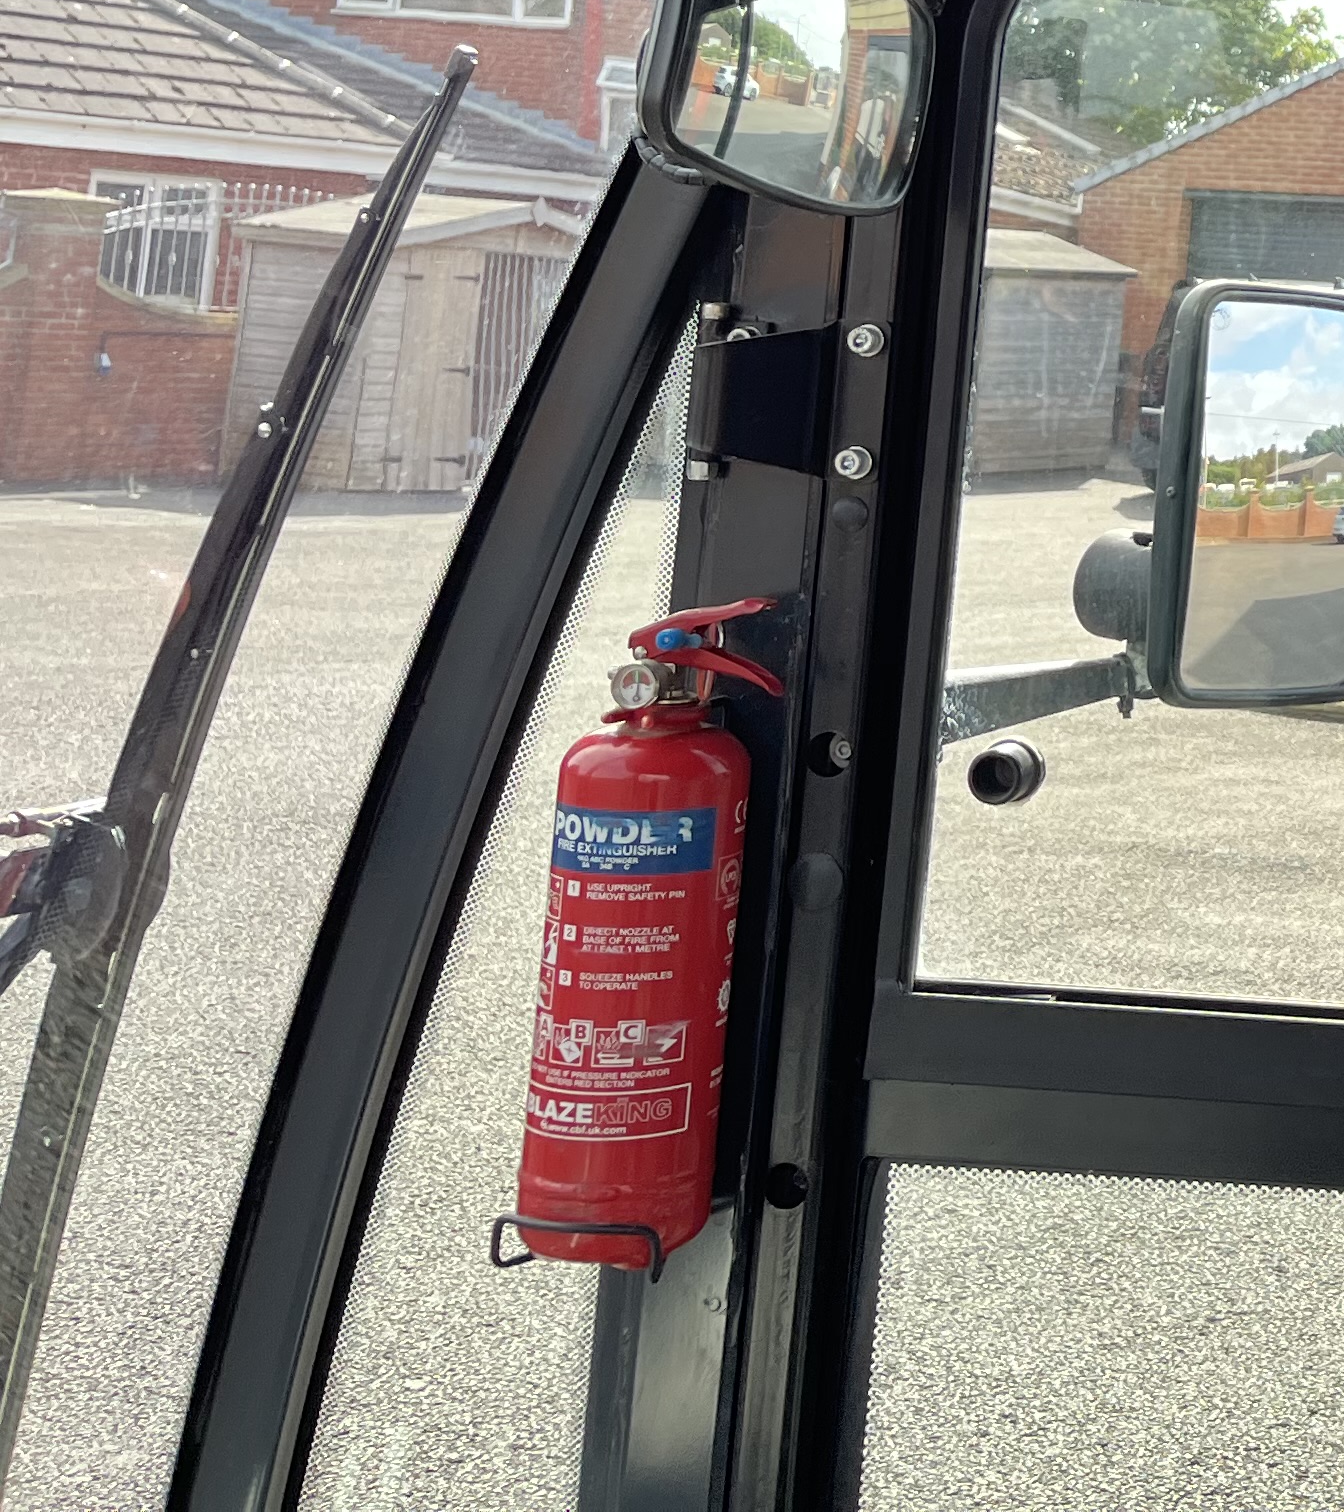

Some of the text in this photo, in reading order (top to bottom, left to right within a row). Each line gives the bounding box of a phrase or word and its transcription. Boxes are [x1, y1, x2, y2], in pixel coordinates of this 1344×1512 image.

[558, 838, 677, 856] FIRE EXTINGUISHER
[587, 883, 652, 892] USE UPRIGHT
[586, 890, 685, 901] REMOVE SAFETY PIN
[583, 925, 674, 935] DIRECT NOZZLE AT
[582, 934, 680, 944] BASE OF FIRE FROM
[581, 944, 594, 952] AT
[635, 943, 670, 953] METRE
[579, 971, 673, 981] SQUEEZE HANDLES
[579, 981, 638, 990] TO OPERATE
[575, 1025, 587, 1039] B
[623, 1024, 639, 1039] C
[571, 1071, 618, 1079] PRESSURE
[620, 1068, 670, 1080] INDICATOR
[574, 1079, 592, 1088] RED
[594, 1079, 635, 1088] SECTION
